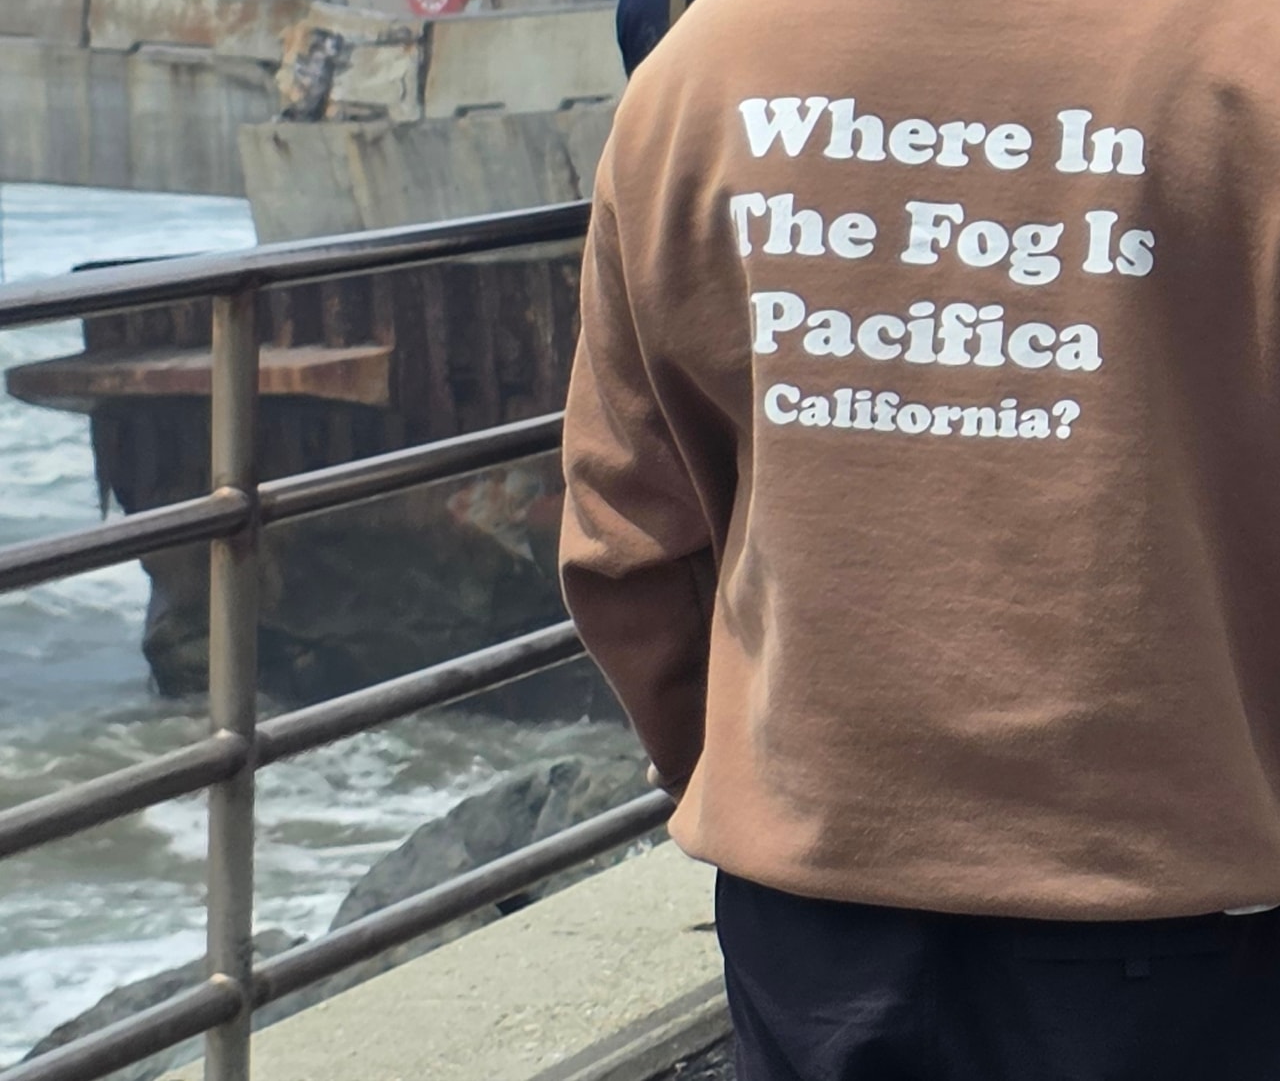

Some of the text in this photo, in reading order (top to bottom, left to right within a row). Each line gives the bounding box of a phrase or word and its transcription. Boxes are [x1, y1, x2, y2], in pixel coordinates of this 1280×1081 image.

[737, 95, 1146, 176] Where In
[729, 191, 1156, 286] The Fog Is
[750, 290, 1103, 372] Pacifica
[763, 383, 1081, 440] California?
